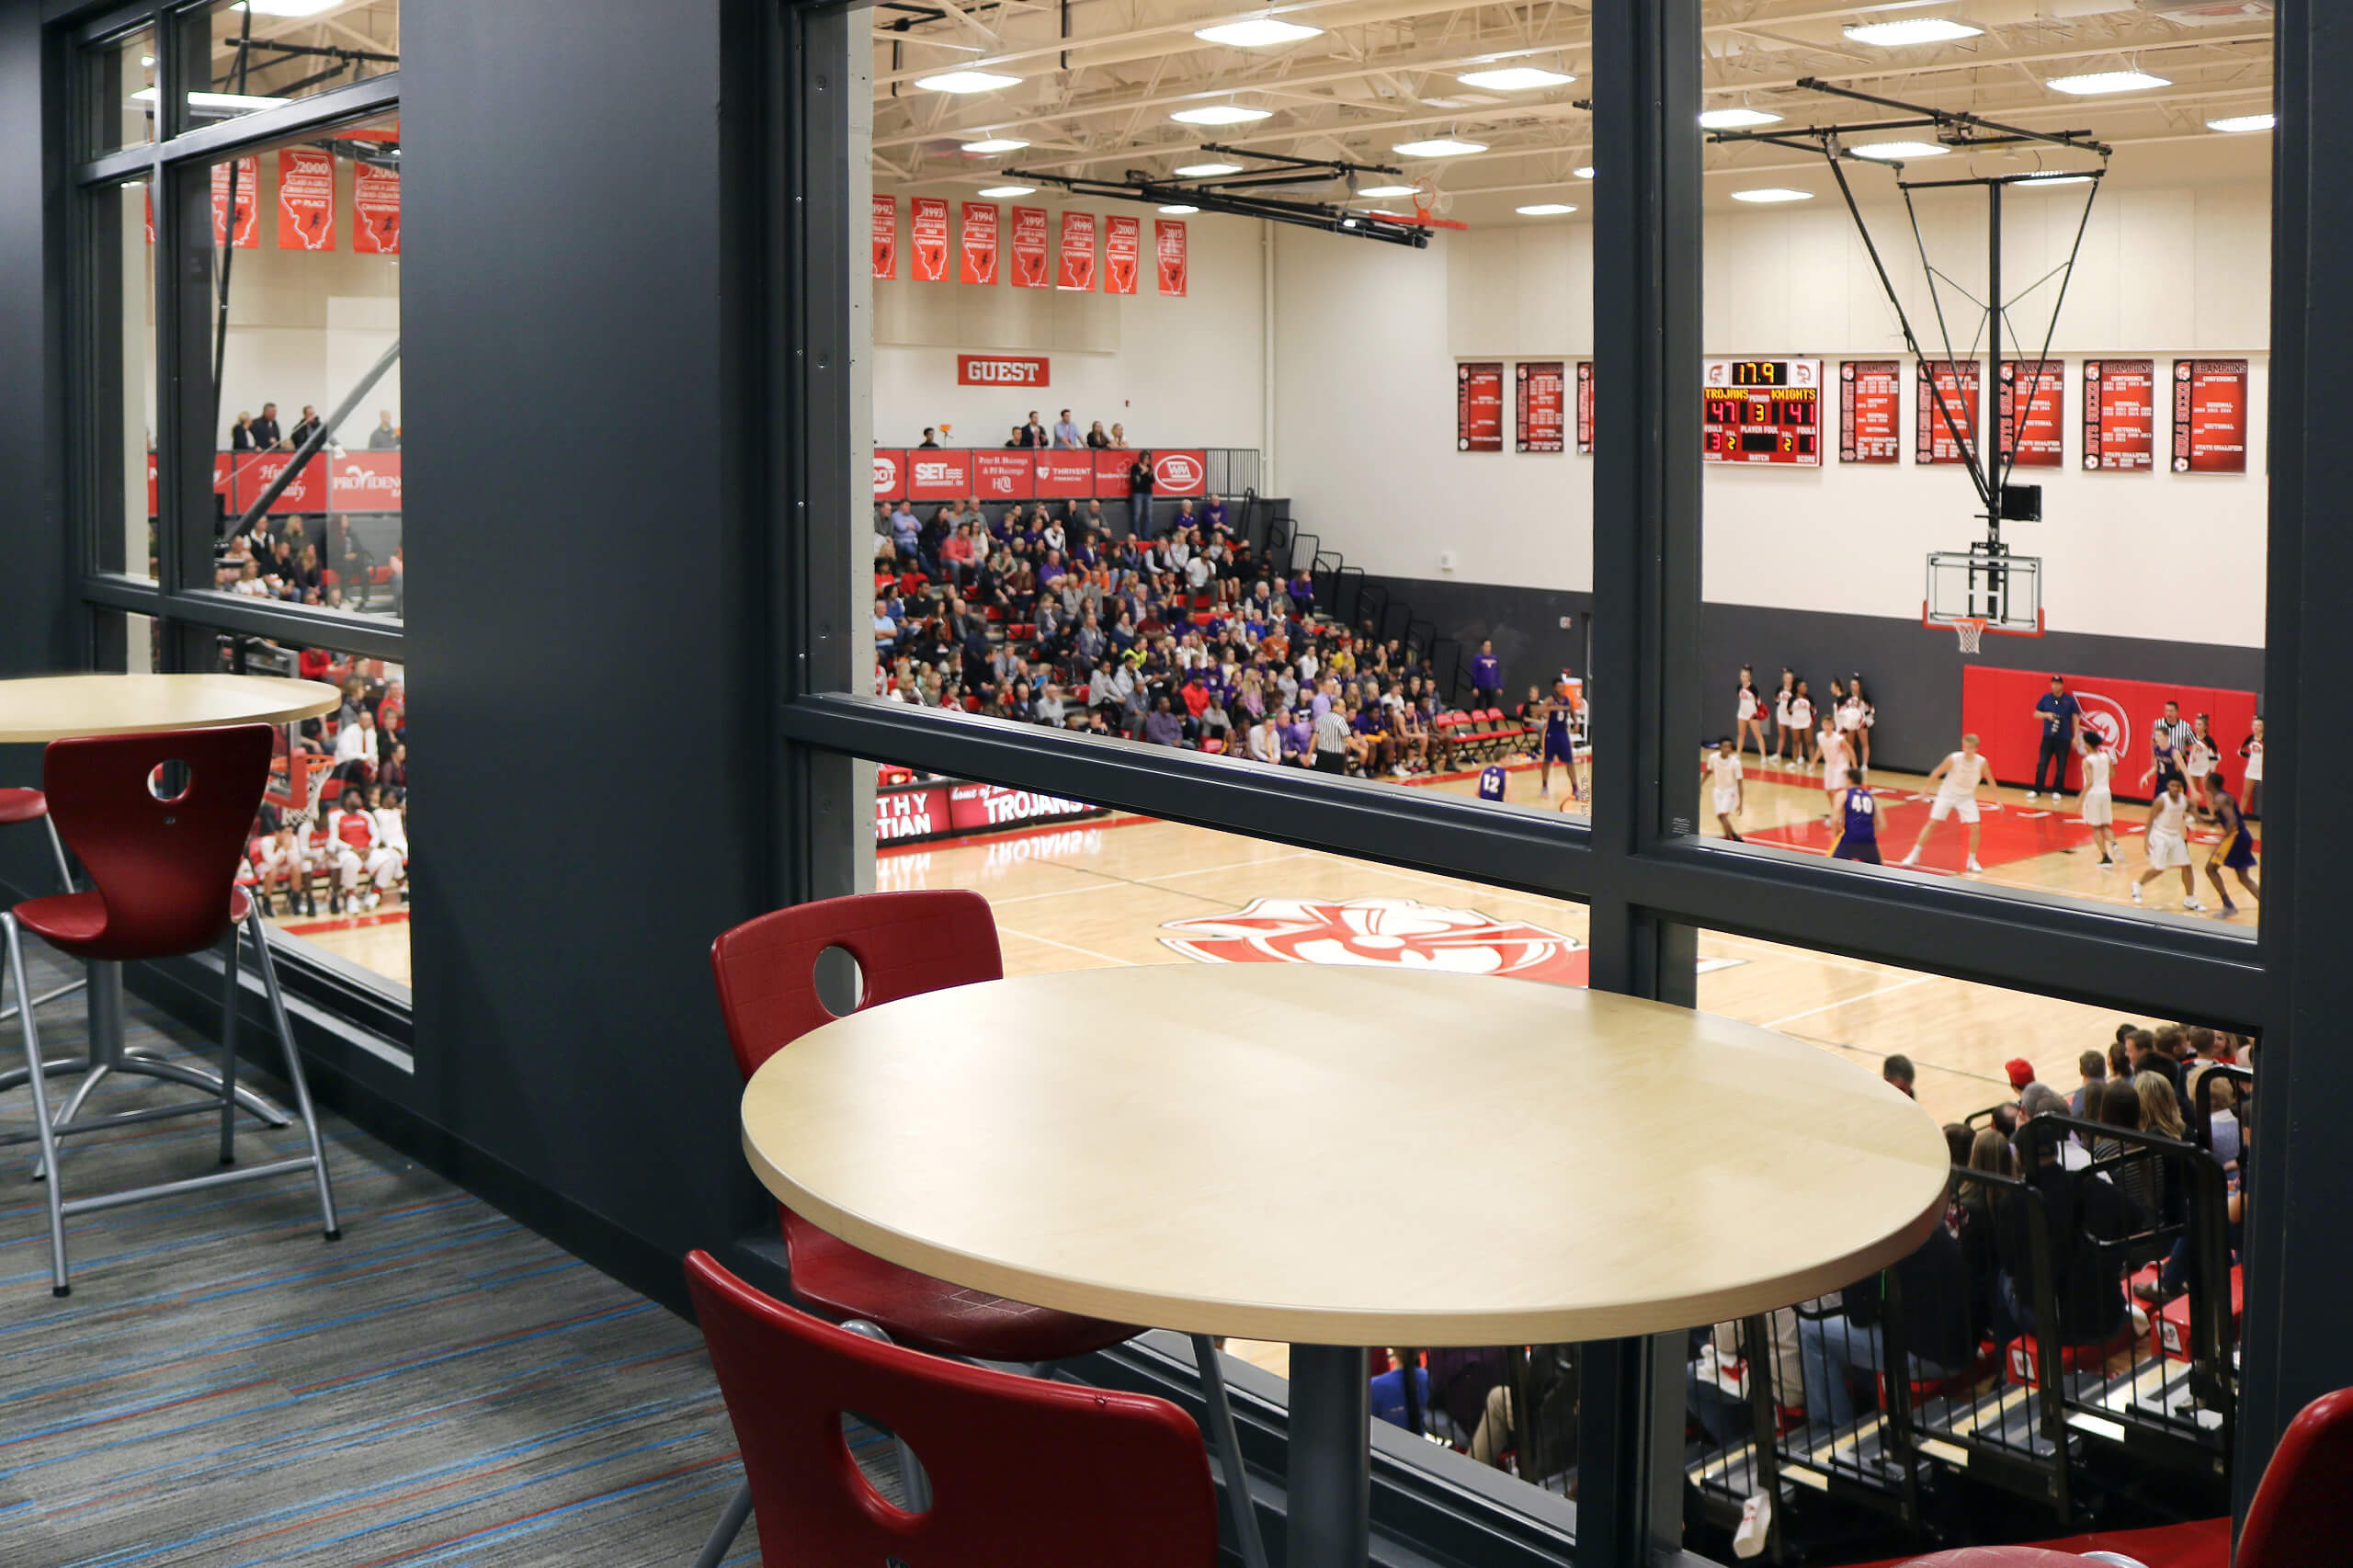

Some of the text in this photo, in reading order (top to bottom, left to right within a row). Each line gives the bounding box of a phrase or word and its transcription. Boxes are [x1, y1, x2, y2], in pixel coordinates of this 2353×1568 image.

[296, 161, 329, 175] 2000
[926, 207, 944, 218] 1993
[973, 211, 994, 222] 1994
[1025, 216, 1045, 228] 1995
[968, 360, 1040, 382] GUEST
[1705, 388, 1749, 400] TROJANS
[1770, 389, 1816, 400] KNIGHTS
[1711, 401, 1735, 422] 47
[1755, 403, 1765, 422] 3
[1790, 403, 1814, 423] 41
[1711, 432, 1721, 450] 3
[915, 462, 948, 479] SET
[1052, 467, 1092, 475] THRIVENT
[1483, 773, 1500, 794] 12
[983, 791, 1085, 824] TROJANS
[1851, 793, 1873, 813] 40
